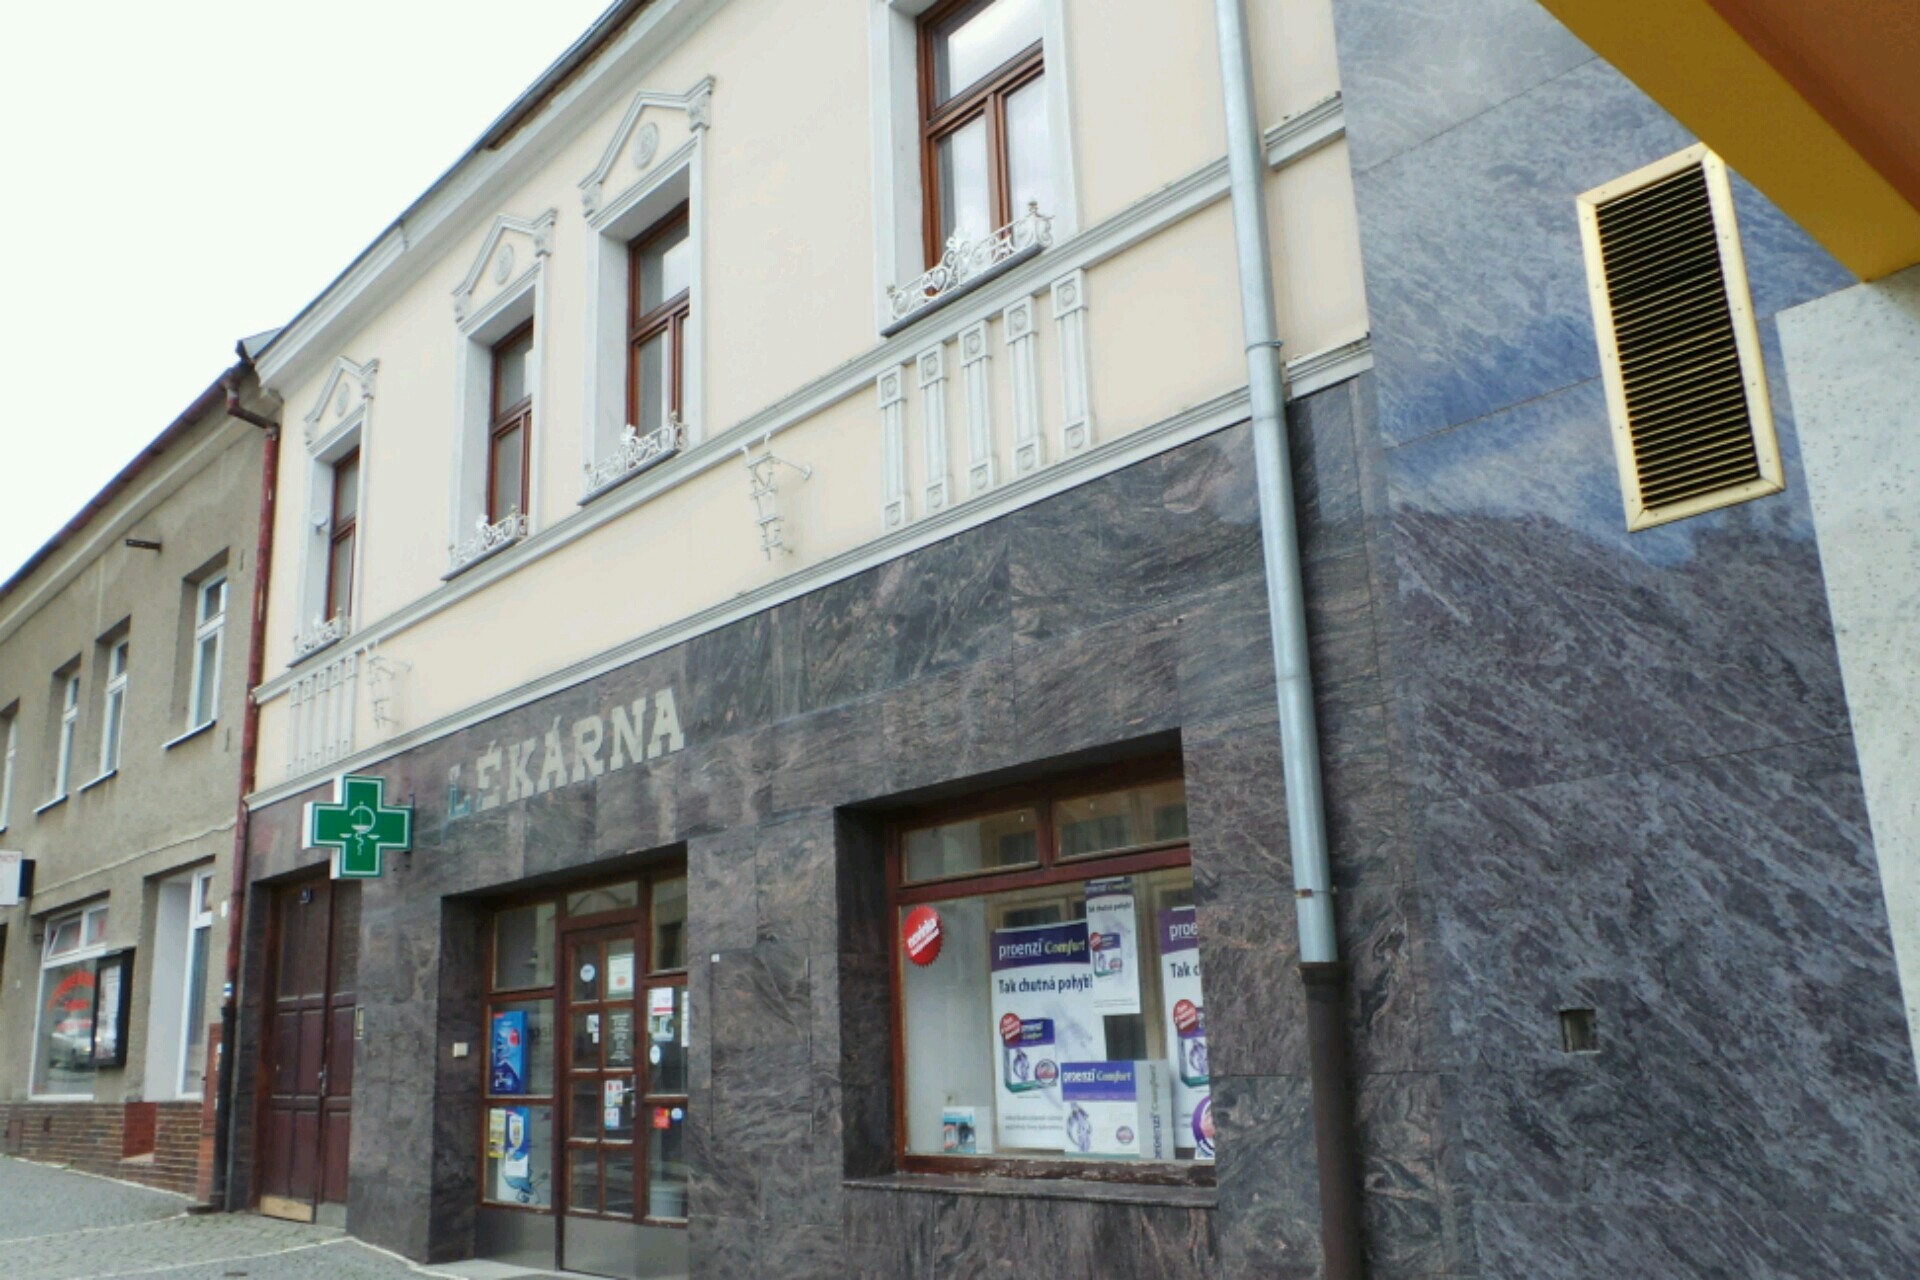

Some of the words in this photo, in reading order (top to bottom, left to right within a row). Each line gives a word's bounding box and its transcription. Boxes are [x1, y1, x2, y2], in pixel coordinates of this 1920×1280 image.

[448, 688, 684, 820] LÉKÁRNA
[1044, 938, 1086, 956] Comfort
[1170, 961, 1191, 978] Tak
[998, 978, 1017, 994] Tak
[1019, 975, 1056, 992] chutná
[1058, 973, 1093, 994] pohyb!
[1096, 1070, 1132, 1083] Comfort
